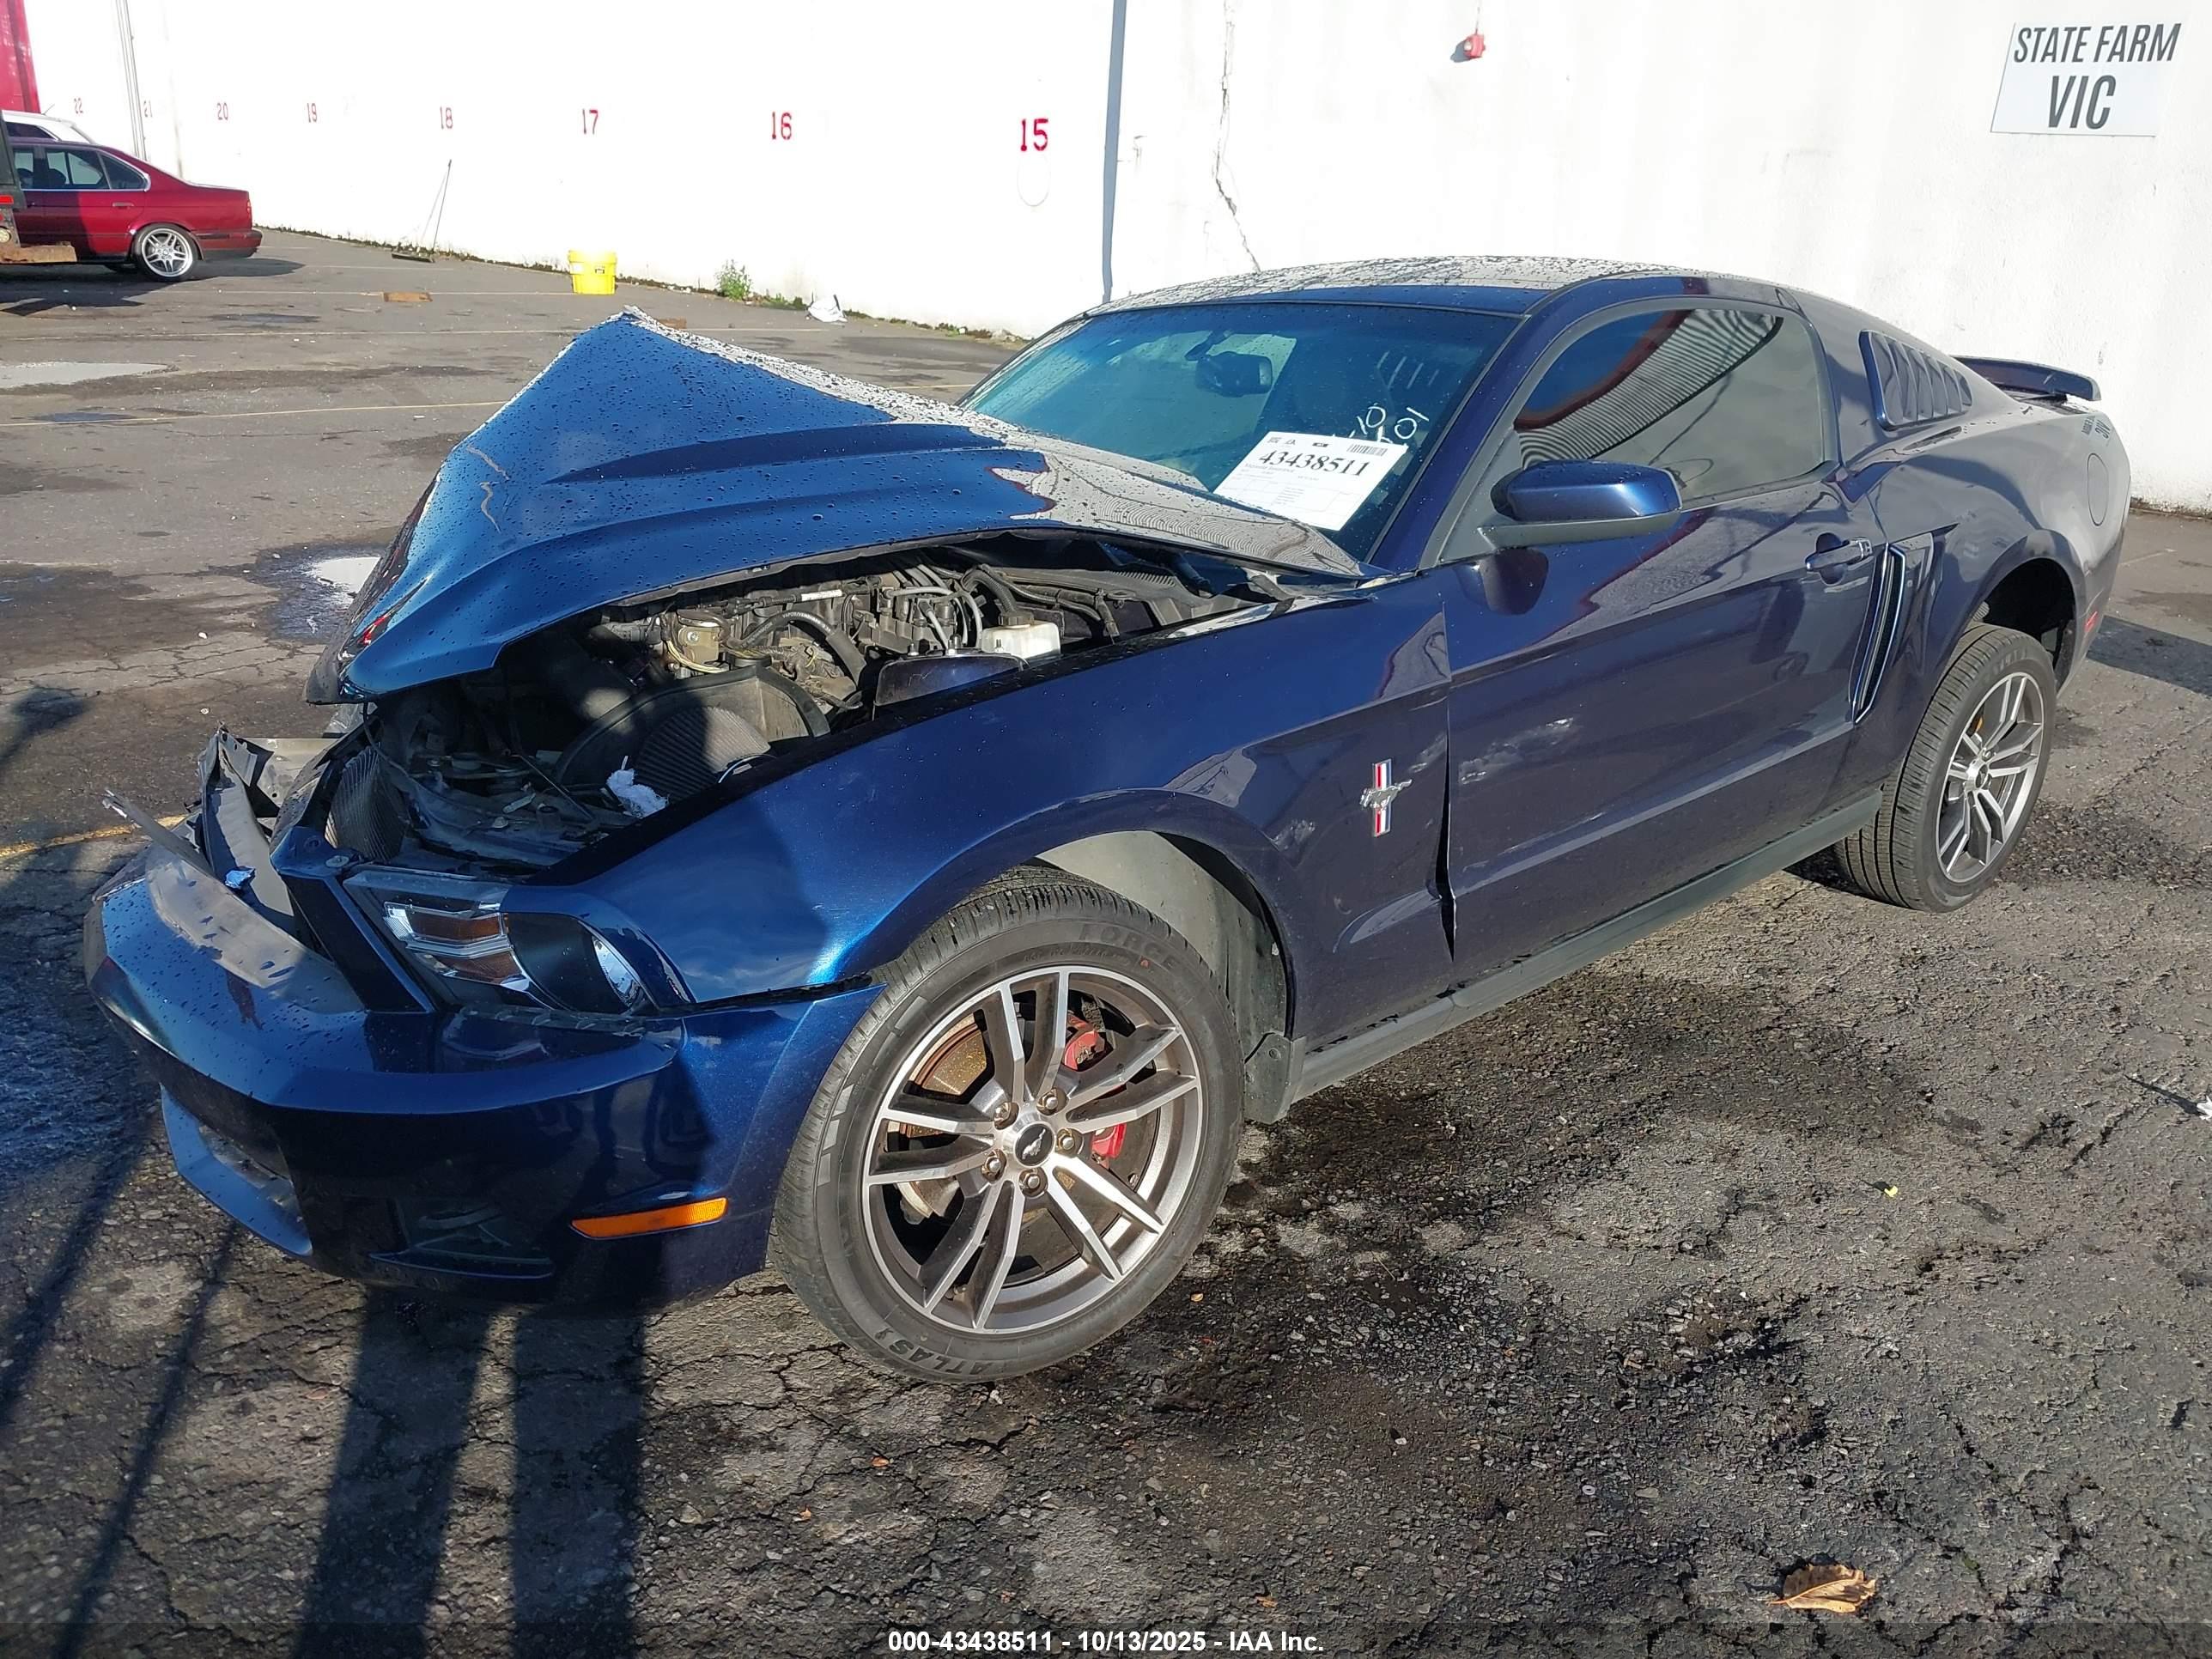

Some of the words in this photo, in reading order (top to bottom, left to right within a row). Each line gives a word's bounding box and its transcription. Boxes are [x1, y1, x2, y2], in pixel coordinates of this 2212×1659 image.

[2014, 27, 2092, 63] STATE
[2094, 23, 2182, 63] FARM
[74, 97, 84, 114] 22
[216, 102, 228, 120] 20
[307, 103, 318, 124] 19
[2048, 75, 2117, 130] VIC
[440, 107, 453, 130] 18
[581, 109, 599, 135] 17
[772, 111, 793, 140] 16
[1019, 118, 1048, 151] 15
[1258, 449, 1370, 477] 43438511
[888, 1339, 994, 1375] ATLAS
